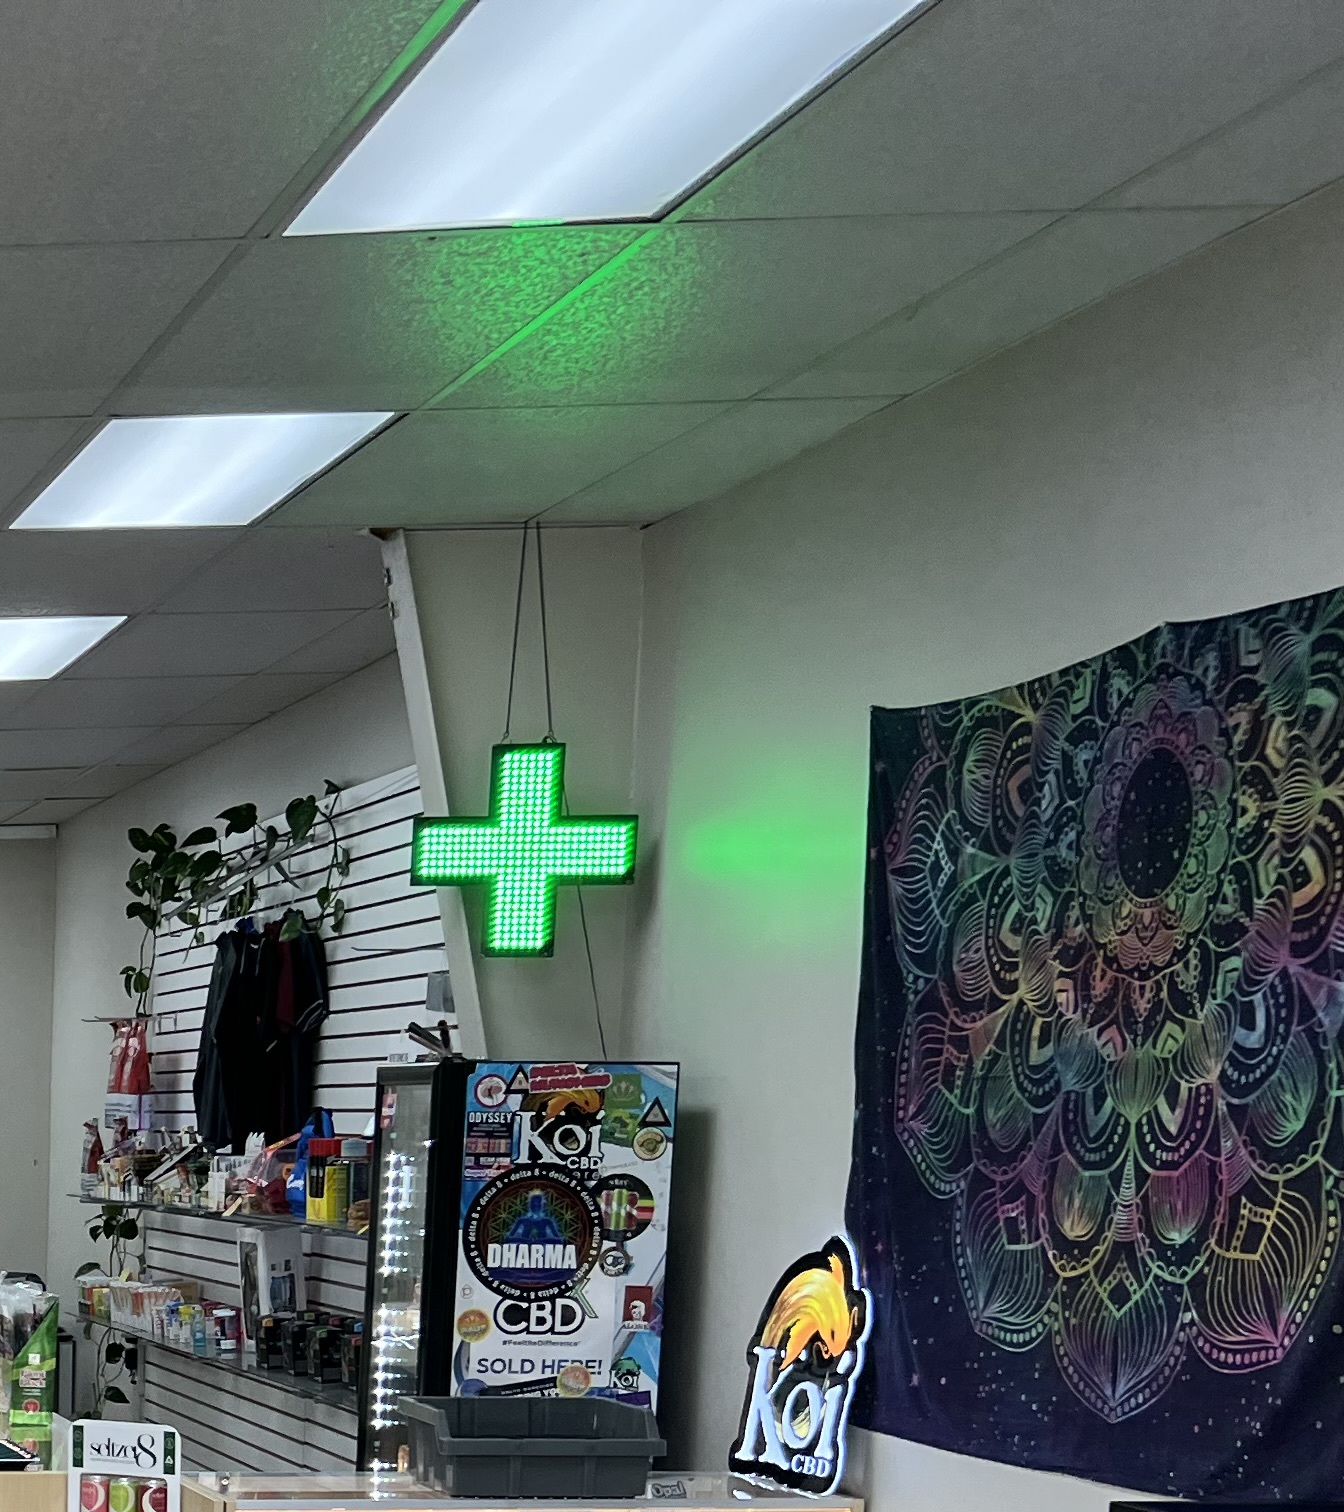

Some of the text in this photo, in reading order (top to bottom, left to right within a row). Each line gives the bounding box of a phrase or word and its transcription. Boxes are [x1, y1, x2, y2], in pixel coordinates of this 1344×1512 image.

[468, 1112, 512, 1123] ODYSSEY
[514, 1110, 606, 1165] Koi
[566, 1156, 602, 1169] CBD
[510, 1170, 531, 1180] delta
[549, 1170, 570, 1183] delta
[479, 1187, 497, 1205] delta
[580, 1191, 594, 1210] delta
[468, 1220, 477, 1241] delta
[487, 1243, 577, 1269] DHARMA
[496, 1297, 583, 1333] CBD
[476, 1358, 603, 1375] SOLD HEE!
[735, 1346, 854, 1470] Koi
[791, 1453, 833, 1477] CBD
[651, 1481, 687, 1499] Opal
